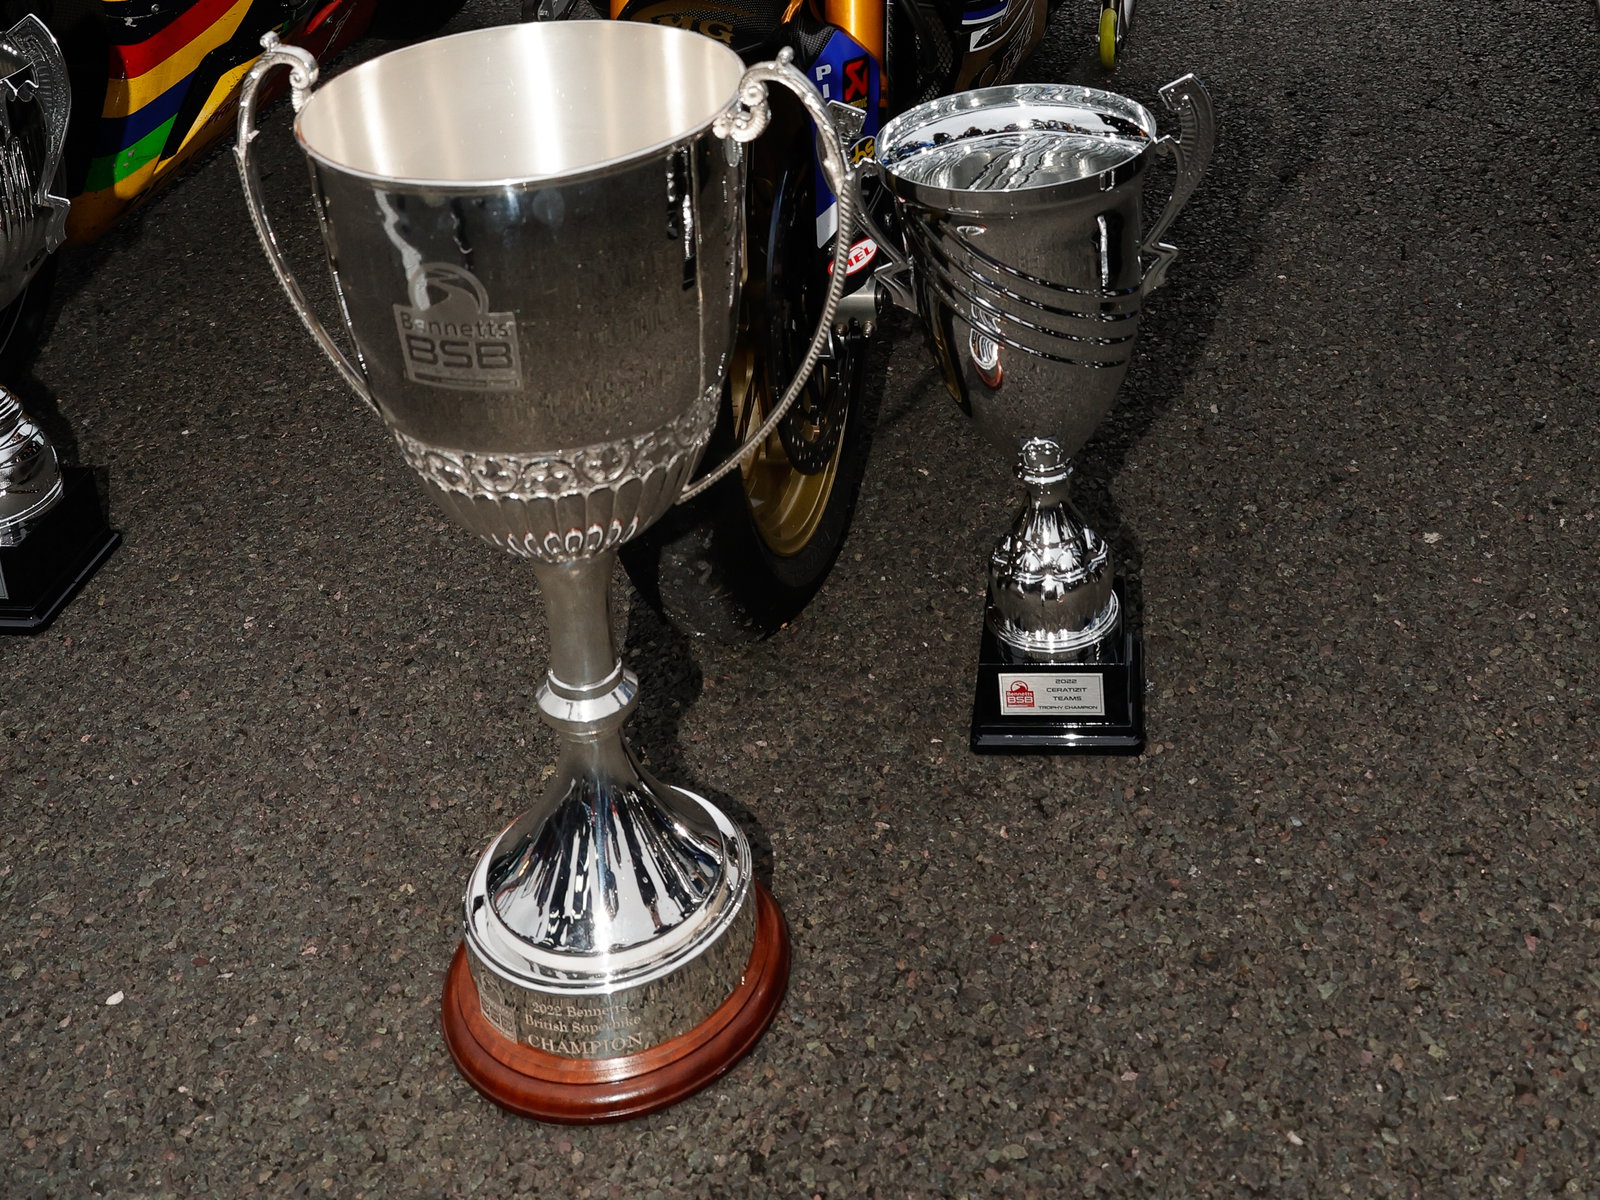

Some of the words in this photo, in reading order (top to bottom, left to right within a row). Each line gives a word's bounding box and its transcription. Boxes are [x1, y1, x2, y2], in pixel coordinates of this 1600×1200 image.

[401, 312, 508, 337] Bennetts
[406, 334, 513, 369] BSB
[1007, 696, 1033, 704] BSB
[532, 1002, 563, 1017] 2022
[525, 1014, 569, 1033] British
[528, 1032, 643, 1055] CHAMPION
